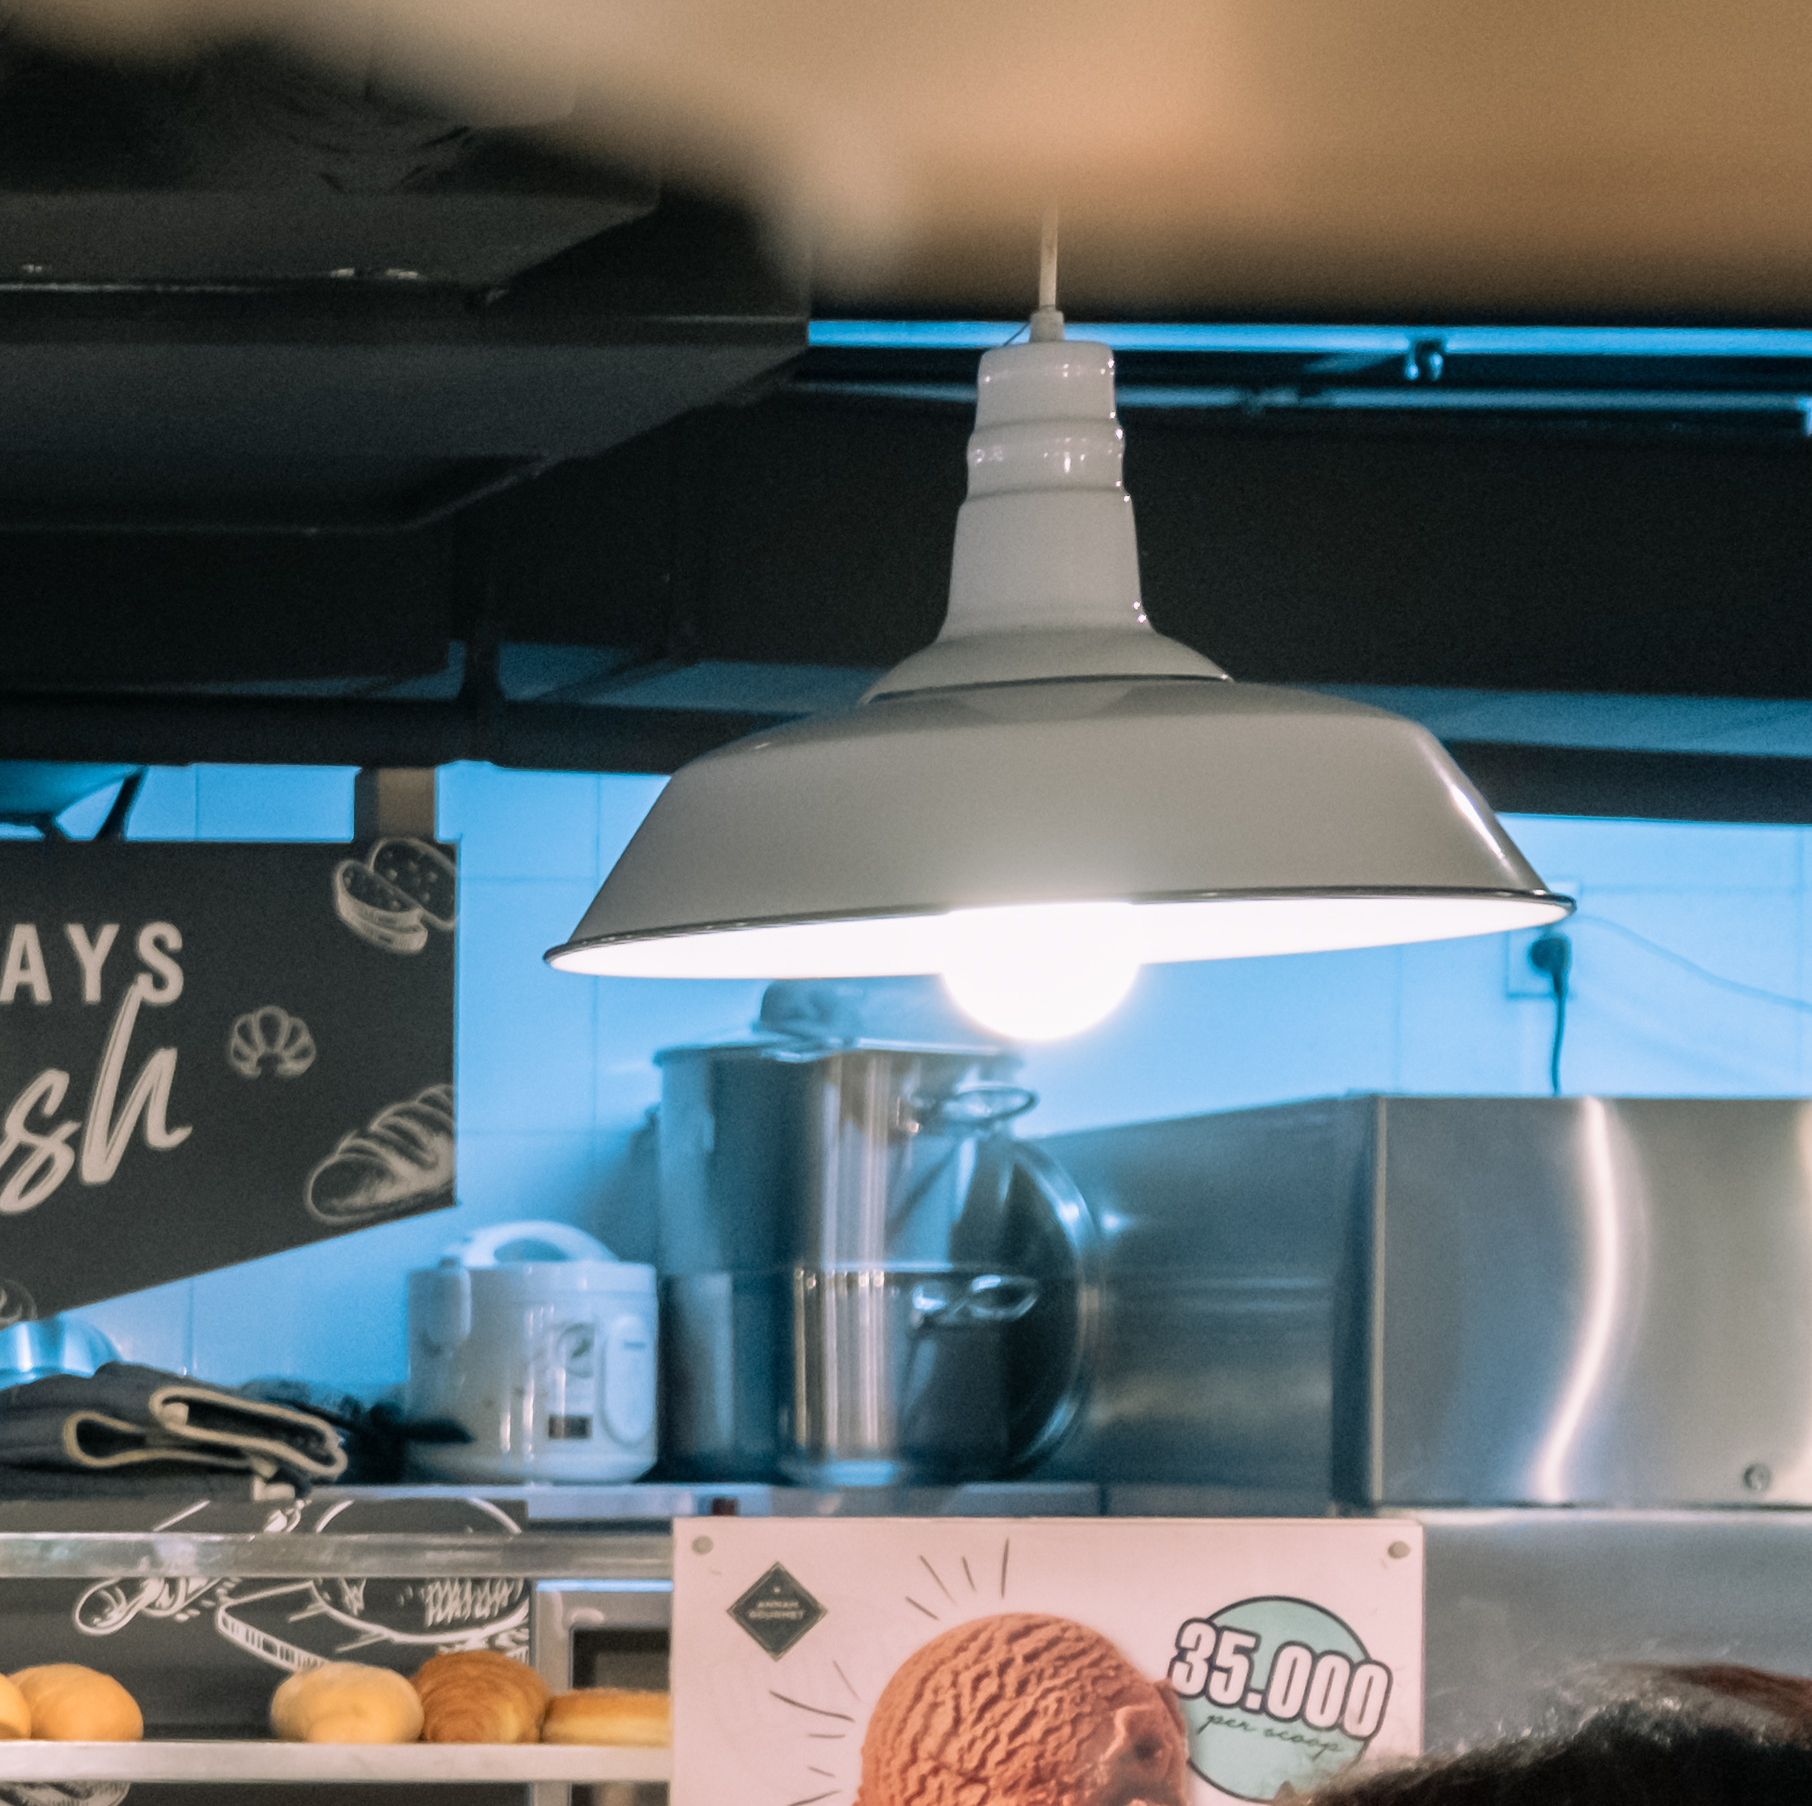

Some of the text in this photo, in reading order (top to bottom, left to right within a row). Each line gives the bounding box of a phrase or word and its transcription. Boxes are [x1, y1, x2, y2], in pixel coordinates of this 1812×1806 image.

[1167, 1616, 1394, 1742] 35.000
[1196, 1712, 1344, 1762] per scoop
